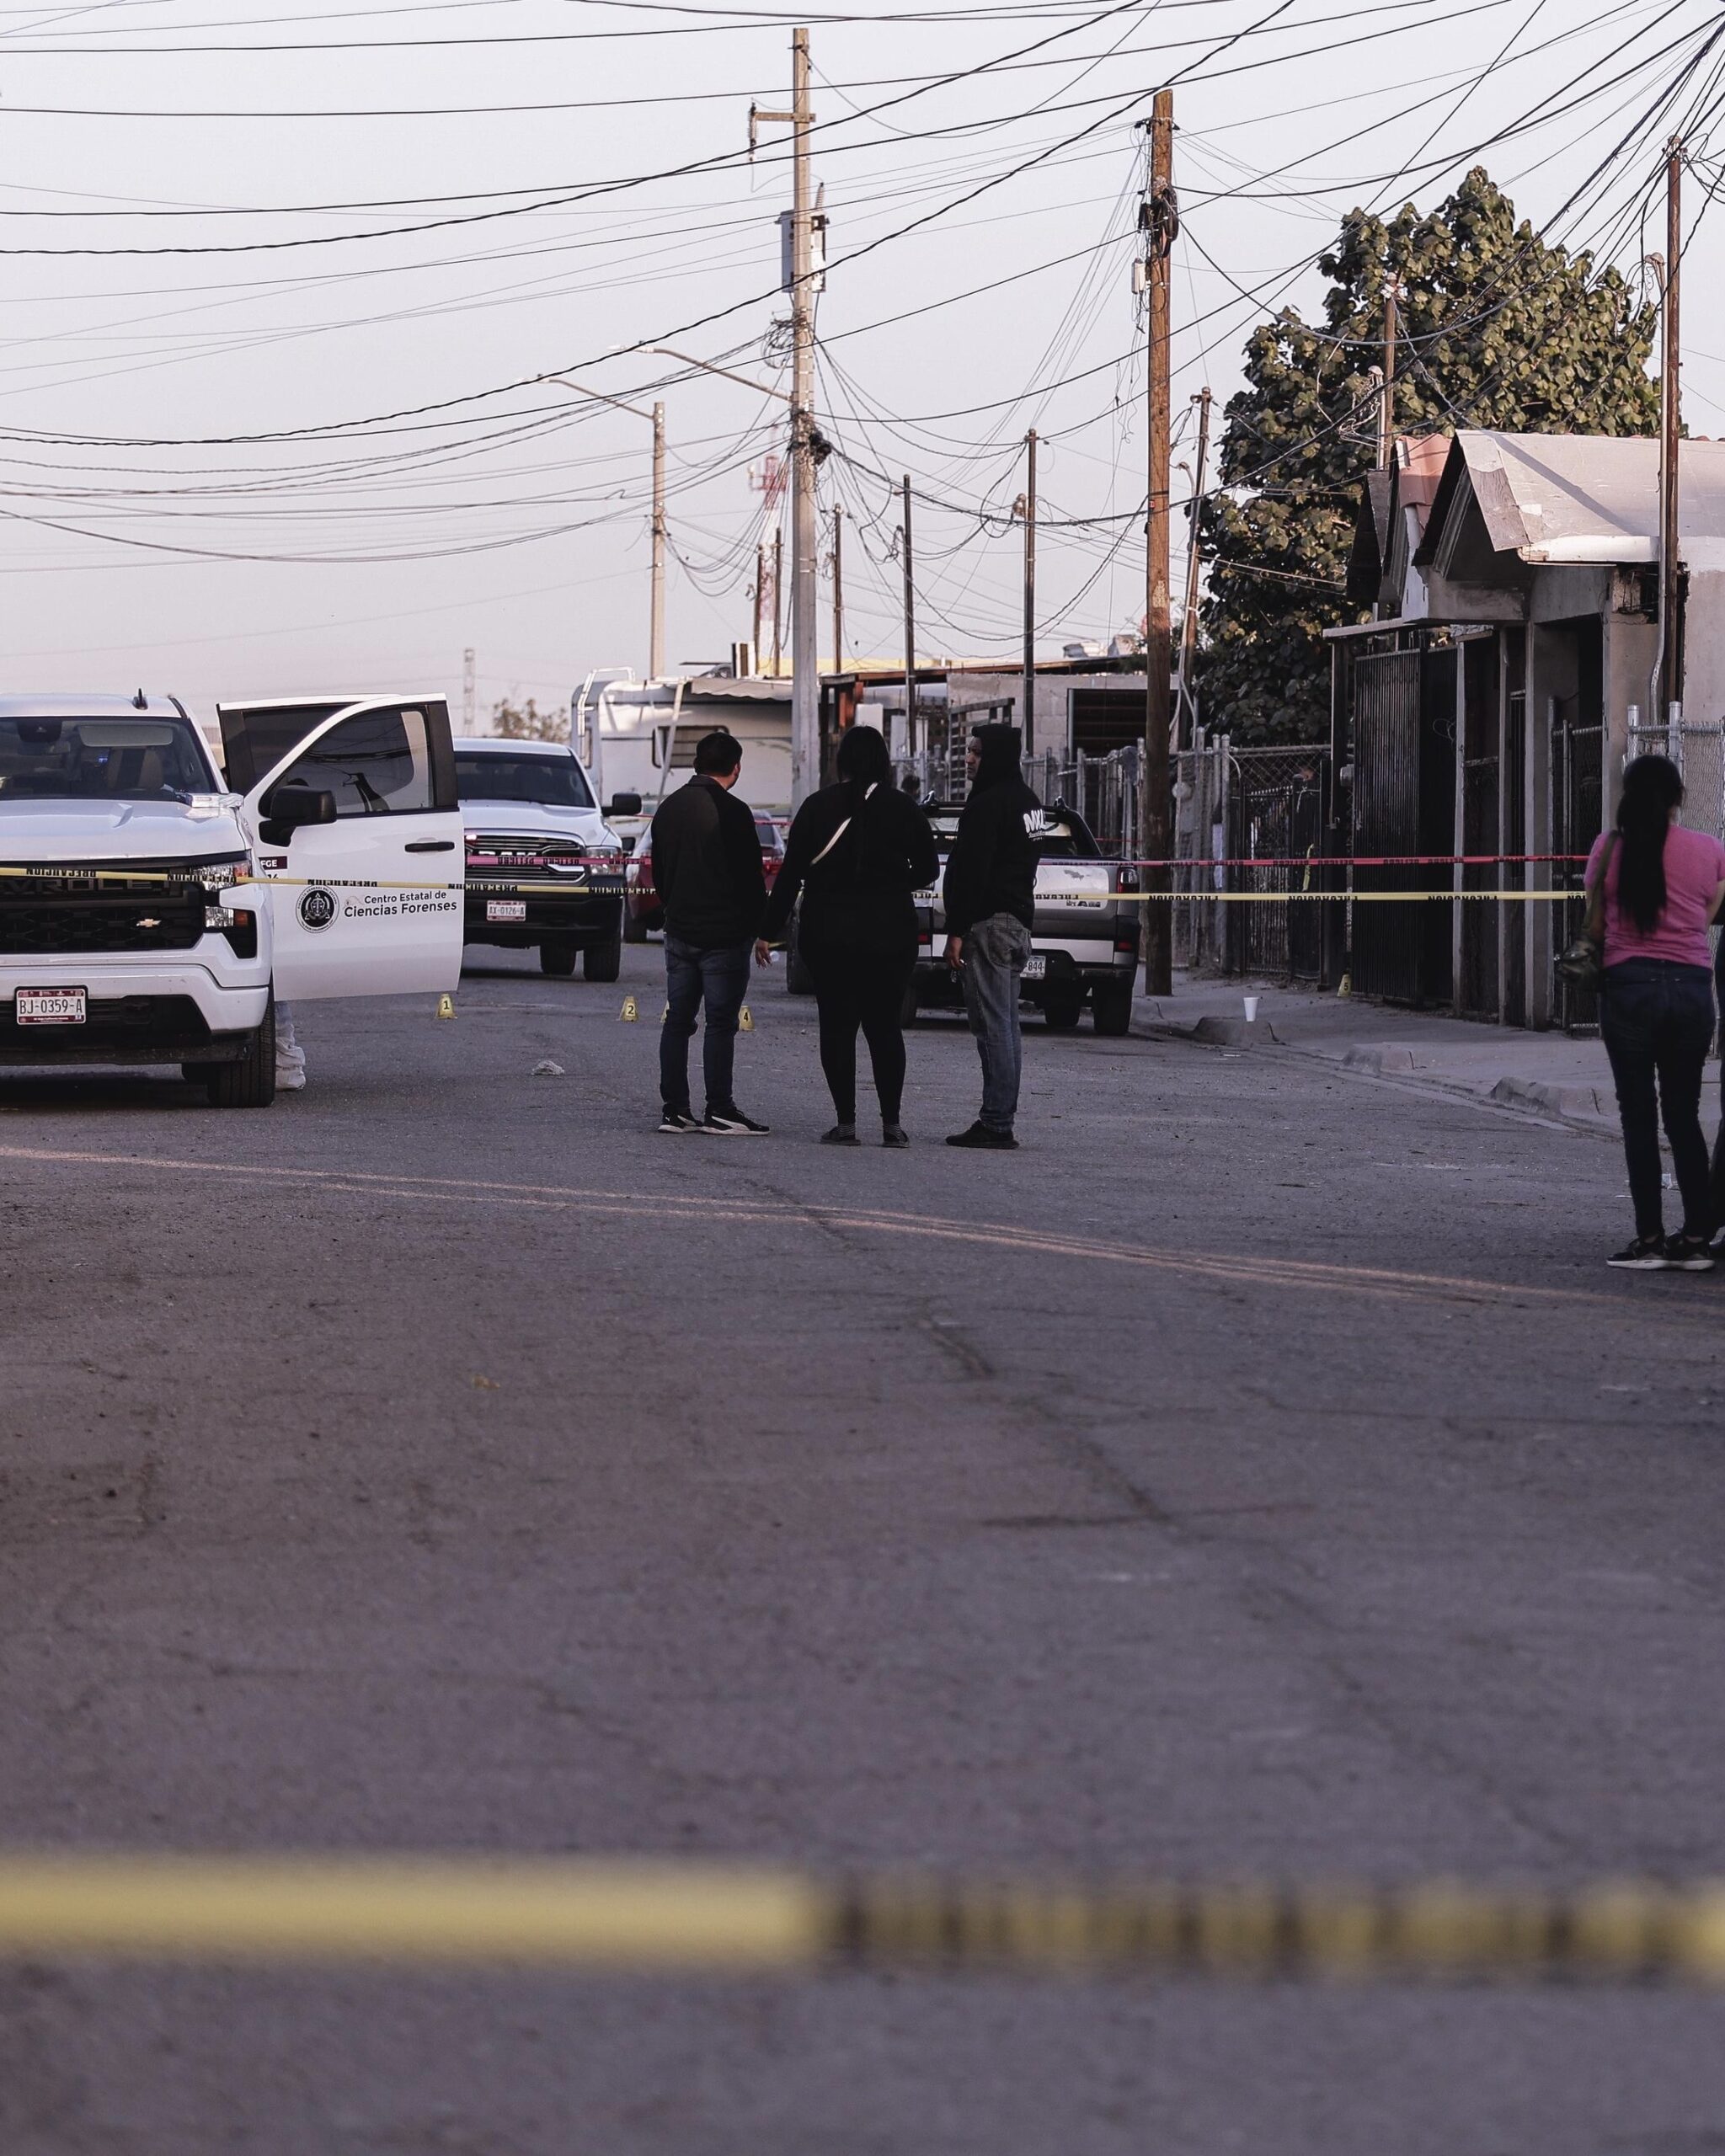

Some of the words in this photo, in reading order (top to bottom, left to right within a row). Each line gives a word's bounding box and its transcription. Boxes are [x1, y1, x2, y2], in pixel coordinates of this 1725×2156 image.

[364, 894, 398, 905] Centro
[399, 891, 432, 902] Estatal
[435, 890, 446, 899] de
[344, 905, 398, 917] Ciencias
[401, 901, 457, 914] Forenses
[19, 998, 83, 1014] BJ-0359-A
[443, 1000, 451, 1011] 1
[628, 1005, 634, 1015] 2
[743, 1011, 749, 1022] 4
